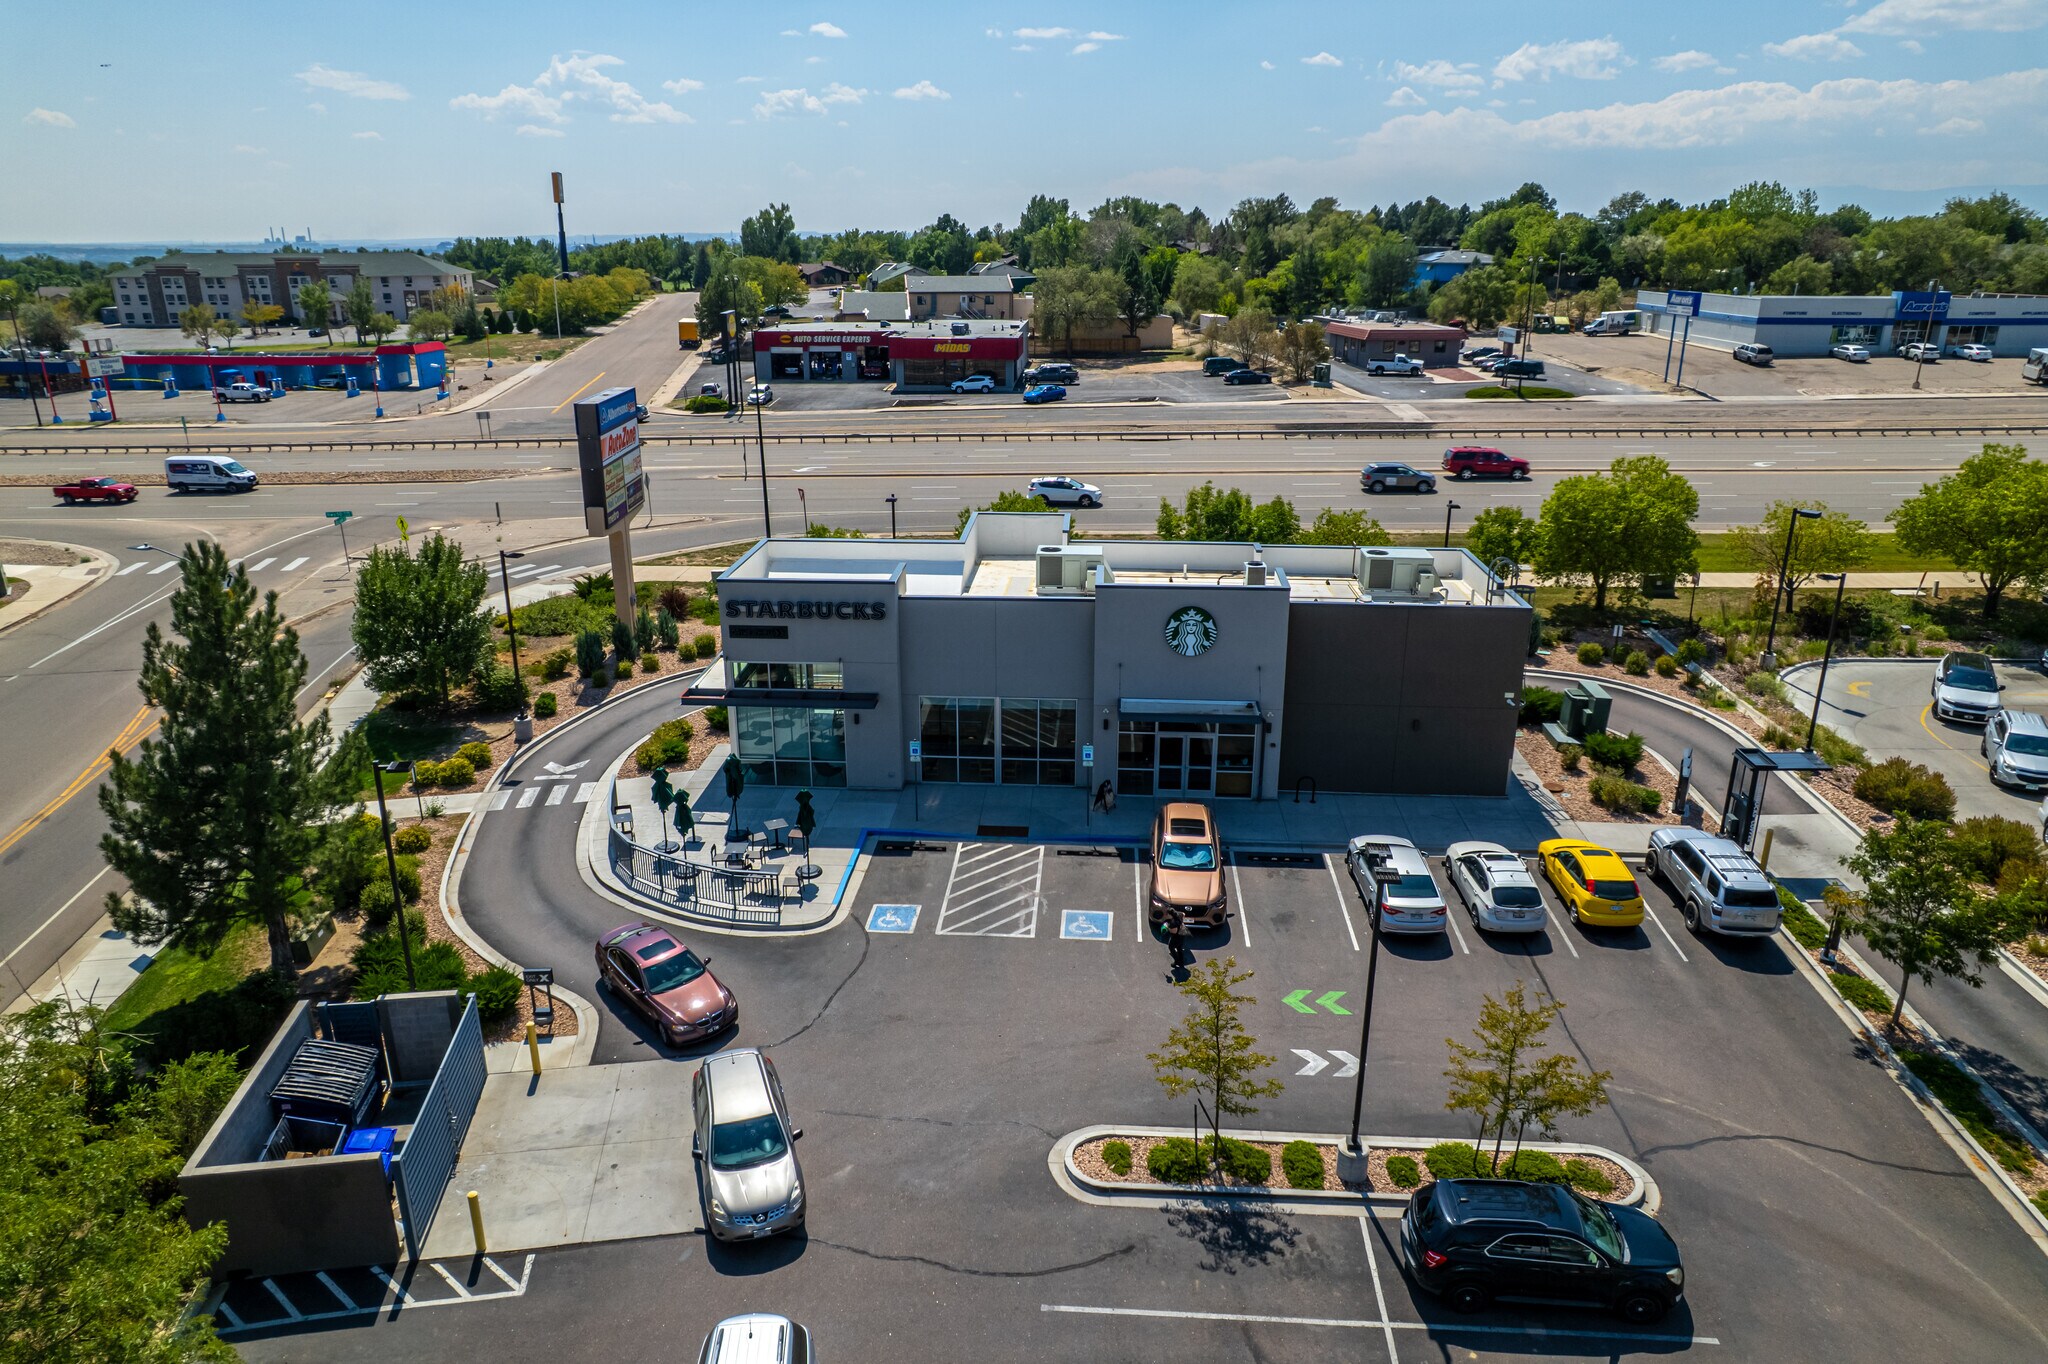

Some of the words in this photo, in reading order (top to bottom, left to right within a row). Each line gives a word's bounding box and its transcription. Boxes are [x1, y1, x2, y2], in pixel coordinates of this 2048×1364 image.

[1902, 300, 1949, 312] Aaron's
[793, 335, 812, 343] AUTO
[813, 335, 841, 343] SERVICE
[842, 335, 872, 343] EXPERTS
[935, 343, 970, 353] MIDAS
[607, 425, 636, 457] AutoZone
[725, 600, 887, 620] STARBUCKS
